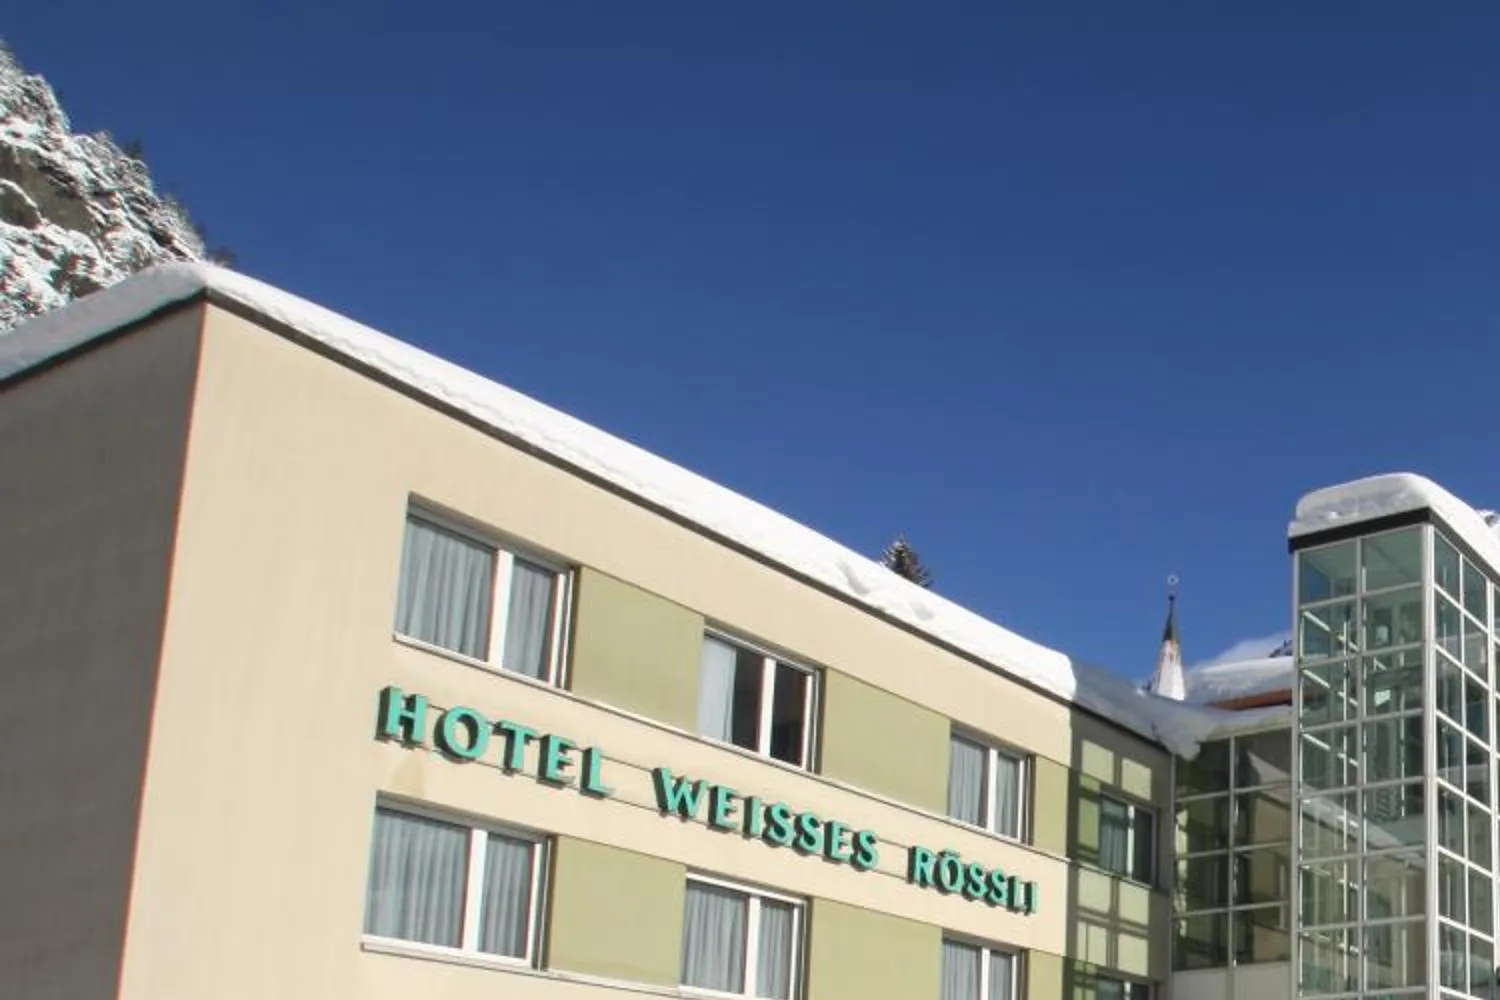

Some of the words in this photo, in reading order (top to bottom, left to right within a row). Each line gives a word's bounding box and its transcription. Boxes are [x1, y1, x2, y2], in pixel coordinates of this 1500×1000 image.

[375, 685, 615, 799] HOTEL
[651, 767, 880, 872] WEISSES
[907, 845, 1039, 916] RÖSSLI
